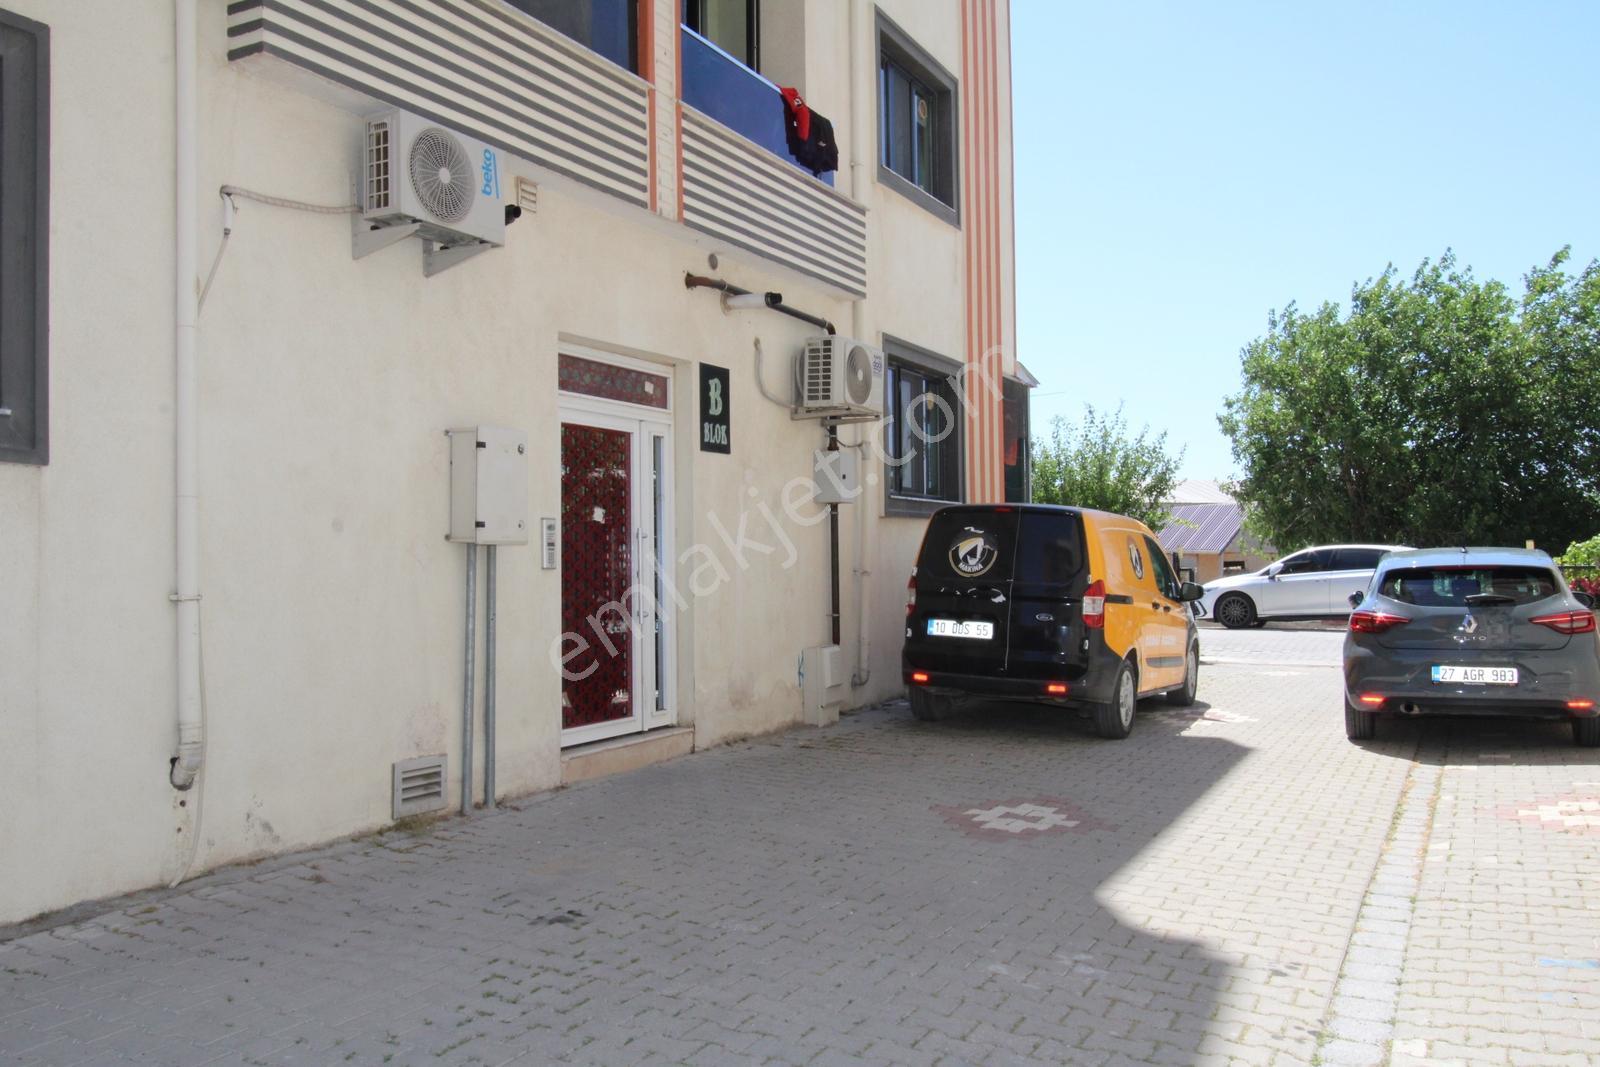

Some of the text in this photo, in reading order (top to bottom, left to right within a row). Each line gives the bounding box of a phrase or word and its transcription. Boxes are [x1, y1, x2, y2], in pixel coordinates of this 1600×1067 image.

[480, 148, 494, 196] beko
[708, 377, 723, 415] B
[703, 421, 728, 445] BLOK
[936, 621, 946, 633] 10
[976, 624, 988, 636] 55
[1441, 668, 1514, 681] 27 AGR 983
